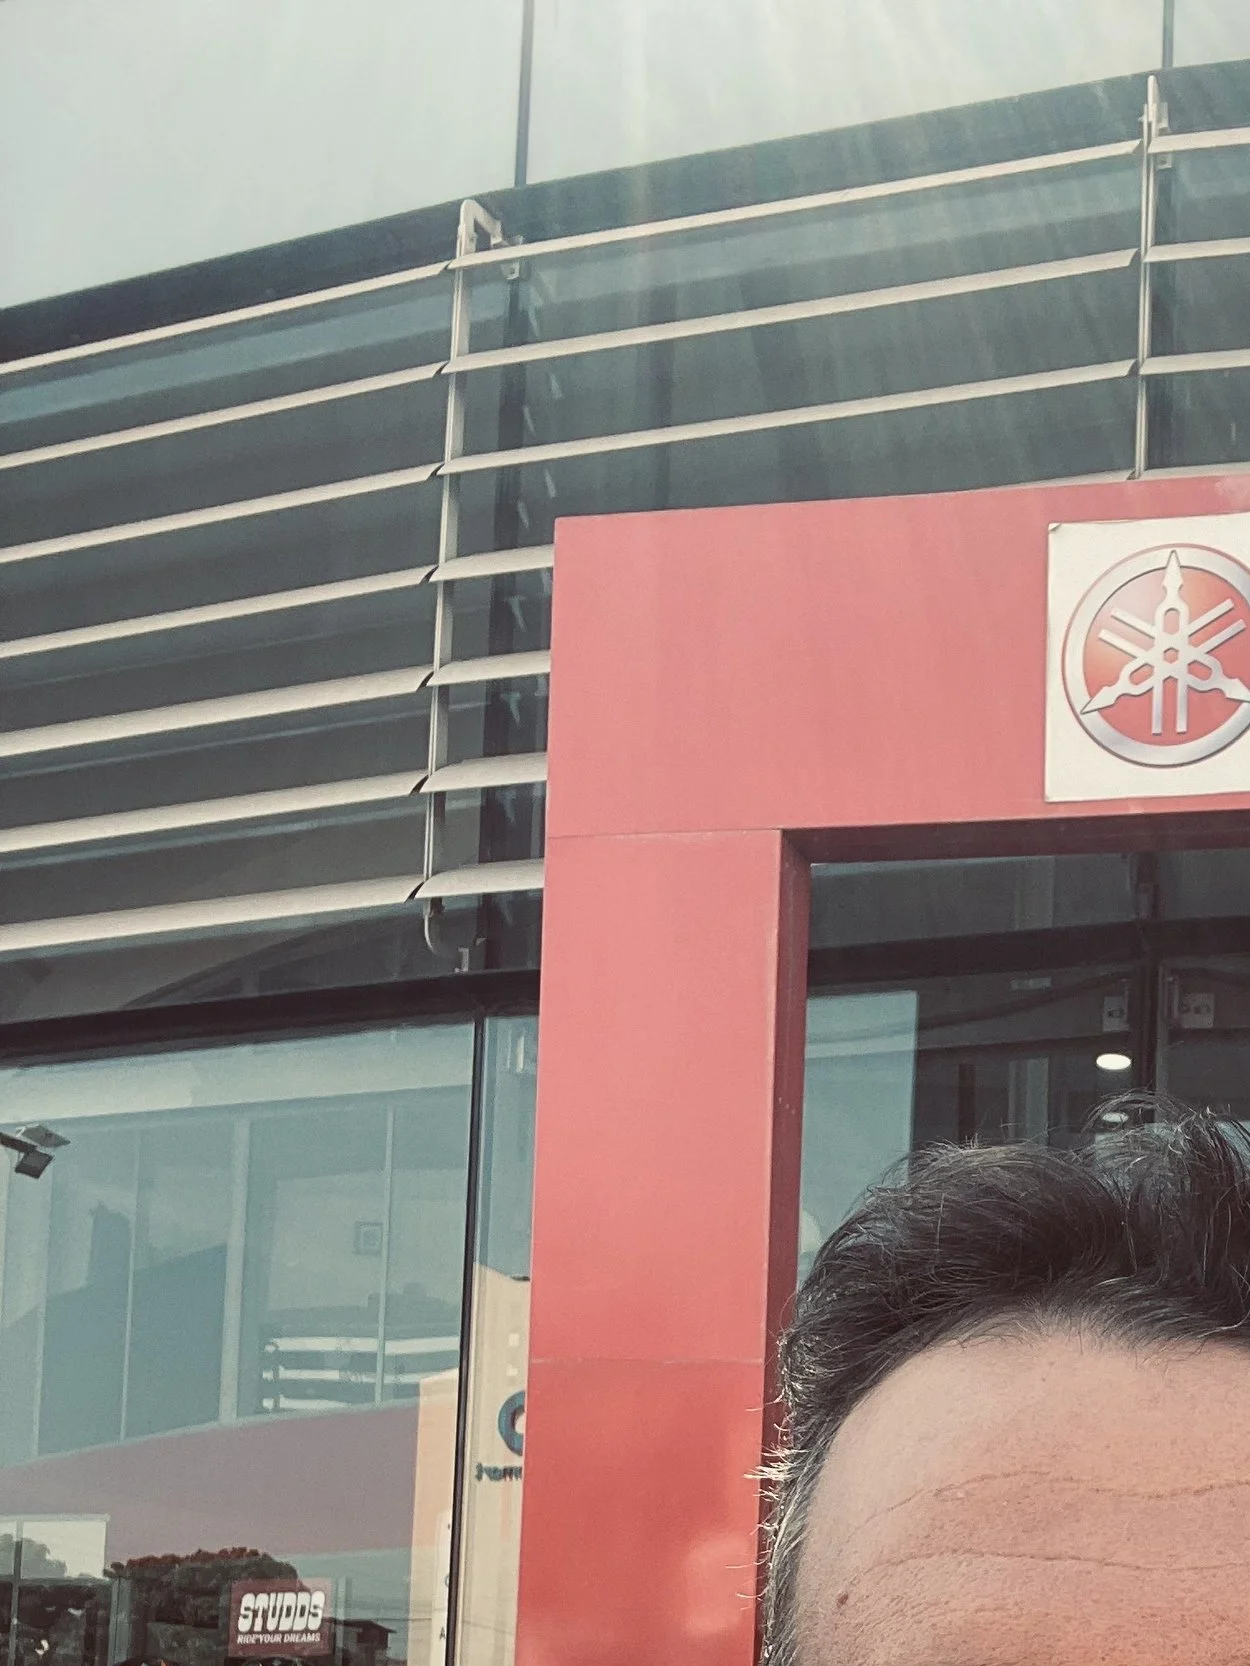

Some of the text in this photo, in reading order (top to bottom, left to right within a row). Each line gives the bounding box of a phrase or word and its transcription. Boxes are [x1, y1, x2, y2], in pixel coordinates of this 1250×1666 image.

[238, 1590, 326, 1632] STUDDS
[237, 1632, 320, 1645] RIDE YOUR DREAMS
